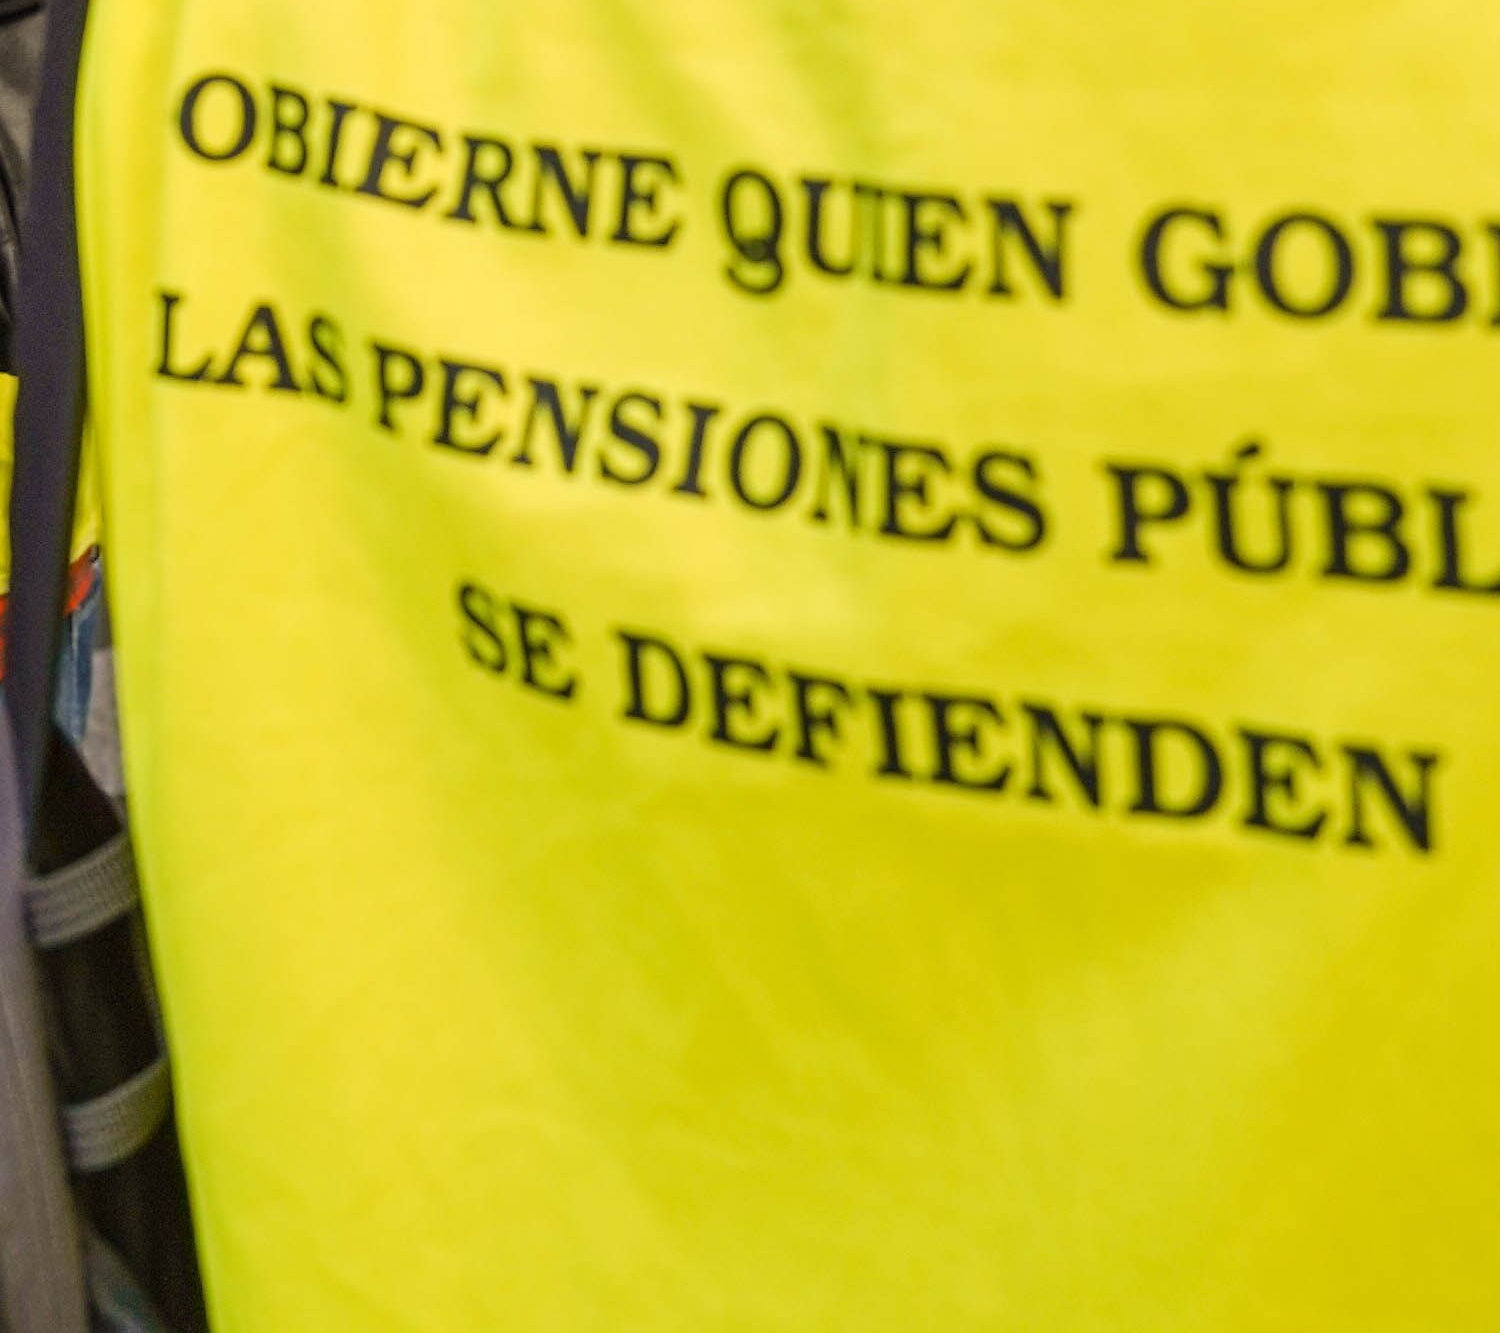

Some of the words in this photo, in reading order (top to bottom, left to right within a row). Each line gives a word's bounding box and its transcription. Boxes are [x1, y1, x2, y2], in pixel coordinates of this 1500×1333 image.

[177, 73, 685, 250] OBIERNE
[155, 290, 348, 404] LAS
[371, 341, 1047, 554] PENSIONES
[459, 583, 579, 701] SE
[609, 631, 1440, 855] DEFIENDEN
